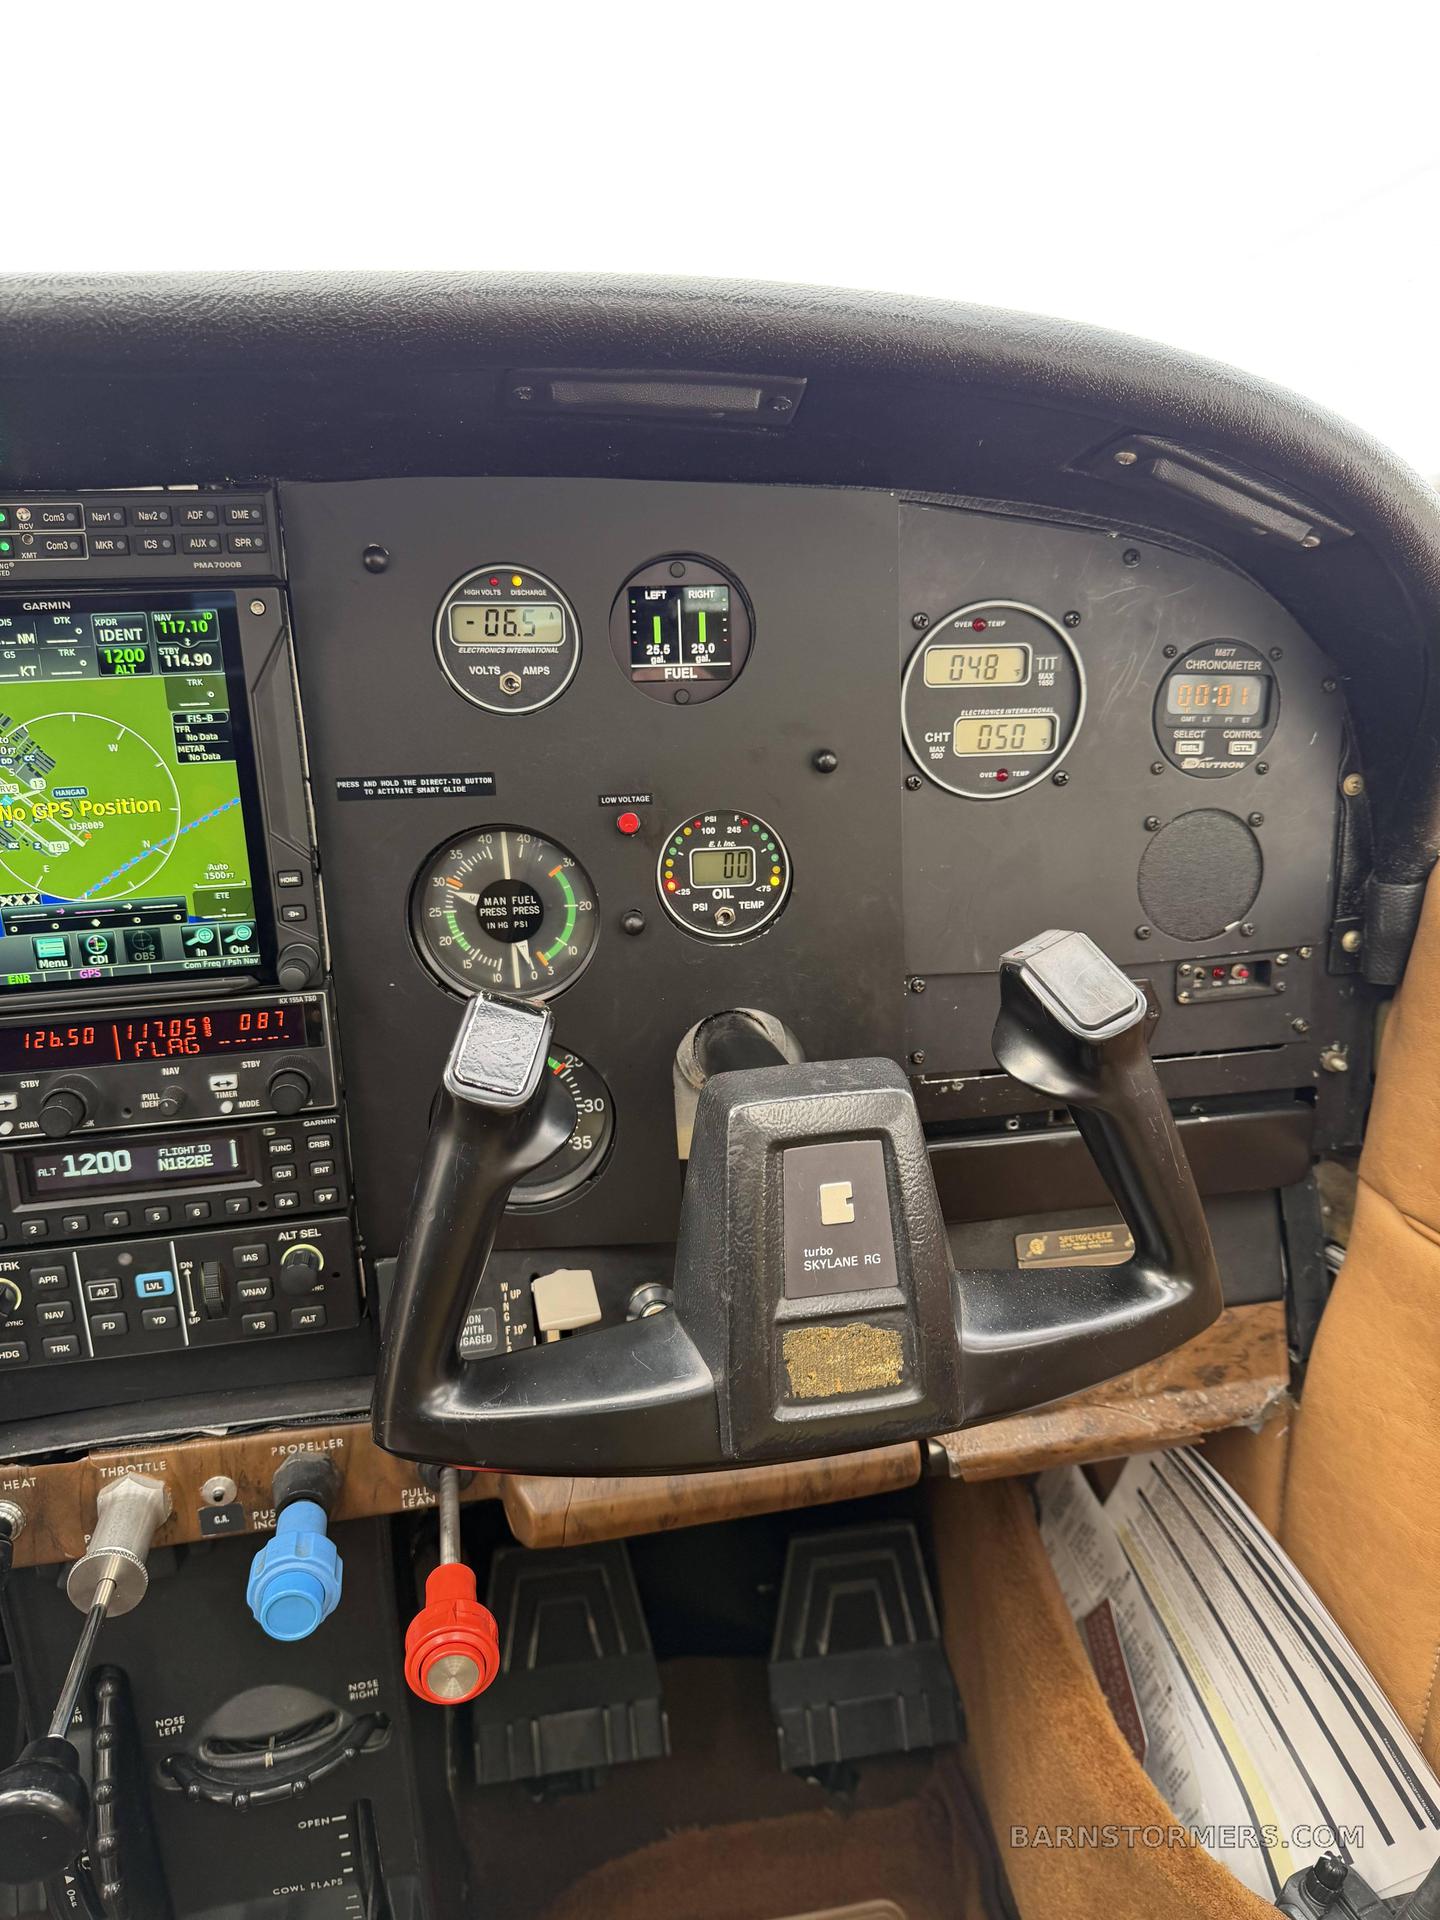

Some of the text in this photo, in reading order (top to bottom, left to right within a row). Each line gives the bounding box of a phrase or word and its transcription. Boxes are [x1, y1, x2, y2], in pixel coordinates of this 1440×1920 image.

[43, 513, 65, 522] Com3
[92, 513, 111, 521] Nav1
[138, 511, 158, 520] Nav2
[187, 511, 203, 520] ADF
[231, 510, 249, 519] DME
[46, 541, 69, 550] Com3
[95, 540, 114, 549] MKR
[144, 540, 158, 549] ICS
[190, 539, 207, 548] AUX
[235, 538, 252, 547] SPR
[193, 561, 242, 569] PMA7000B
[645, 590, 667, 600] LEFT
[688, 590, 715, 599] RIGHT
[23, 601, 71, 611] GARMIN
[53, 616, 71, 625] DTK
[95, 618, 117, 627] XPDR
[154, 614, 172, 622] NAV
[161, 621, 209, 634] 117.10
[17, 633, 35, 644] NM
[100, 629, 143, 642] IDENT
[58, 648, 76, 657] TRK
[159, 647, 179, 656] STBY
[691, 643, 715, 654] 29.0
[4, 651, 16, 659] GS
[104, 648, 145, 663] 1200
[165, 653, 213, 666] 114.90
[114, 664, 136, 675] ALT
[1185, 660, 1262, 671] CHRONOMETER
[20, 666, 37, 677] KT
[469, 666, 501, 675] VOLTS
[523, 666, 550, 675] AMPS
[664, 668, 698, 679] FUEL
[186, 678, 203, 687] TRK
[187, 714, 214, 723] FIS-B
[924, 732, 951, 743] CHT
[1173, 730, 1206, 739] SELECT
[1223, 730, 1262, 739] CONTROL
[178, 744, 206, 753] METAR
[465, 777, 493, 785] BUTTON
[55, 788, 87, 797] HANGAR
[601, 795, 650, 804] LOW VOLTAGE
[0, 798, 161, 821] No GPS Position
[477, 834, 492, 843] 40
[516, 834, 531, 843] 40
[450, 850, 464, 859] 35
[208, 863, 229, 871] Auto
[433, 877, 446, 887] 30
[712, 889, 735, 900] OIL
[484, 896, 537, 906] MAN FUEL
[739, 900, 765, 909] TEMP
[579, 901, 592, 911] 20
[692, 903, 708, 912] PSI
[429, 908, 442, 918] 25
[480, 906, 540, 917] PRESS PRESS
[439, 936, 452, 946] 20
[230, 945, 251, 954] Out
[89, 955, 109, 964] CDI
[134, 951, 156, 961] OBS
[40, 959, 68, 968] Menu
[80, 969, 101, 979] GPS
[7, 974, 32, 984] ENR
[240, 1010, 285, 1031] 087
[134, 1038, 200, 1058] FLAG
[242, 1060, 260, 1069] STBY
[162, 1067, 180, 1076] NAV
[20, 1080, 40, 1089] STBY
[142, 1093, 160, 1101] PULL
[215, 1090, 238, 1099] TIMER
[239, 1099, 260, 1108] MODE
[584, 1098, 604, 1113] 30
[303, 1118, 337, 1127] GARMIN
[270, 1143, 292, 1152] FUNC
[308, 1139, 330, 1148] CRSR
[572, 1136, 592, 1150] 35
[159, 1144, 212, 1156] FLIGHT ID
[62, 1151, 132, 1177] 1200
[158, 1156, 214, 1172] N182BE
[38, 1167, 57, 1177] ALT
[276, 1170, 292, 1178] CLR
[314, 1166, 330, 1174] ENT
[278, 1228, 321, 1241] ALT SEL
[804, 1246, 834, 1257] turbo
[242, 1252, 259, 1262] IAS
[180, 1260, 193, 1269] DN
[804, 1254, 881, 1271] SKYLANE RG
[38, 1275, 59, 1285] APR
[145, 1280, 163, 1291] LVL
[96, 1287, 110, 1297] AP
[242, 1287, 267, 1297] VNAV
[510, 1289, 521, 1299] UP
[44, 1311, 64, 1320] NAV
[152, 1315, 167, 1325] YD
[300, 1314, 317, 1324] ALT
[188, 1316, 201, 1325] UP
[253, 1320, 266, 1330] VS
[102, 1321, 116, 1330] FD
[50, 1344, 71, 1353] TRK
[0, 1350, 20, 1359] HDG
[271, 1438, 344, 1456] PROPELLER
[3, 1477, 37, 1490] HEAT
[402, 1486, 429, 1499] PULL
[402, 1495, 436, 1509] LEAN
[348, 1679, 379, 1692] NOSE
[349, 1687, 380, 1701] RIGHT
[155, 1715, 186, 1729] NOSE
[159, 1724, 183, 1737] LEFT
[297, 1816, 330, 1829] OPEN
[272, 1878, 344, 1896] COWL FLAPS
